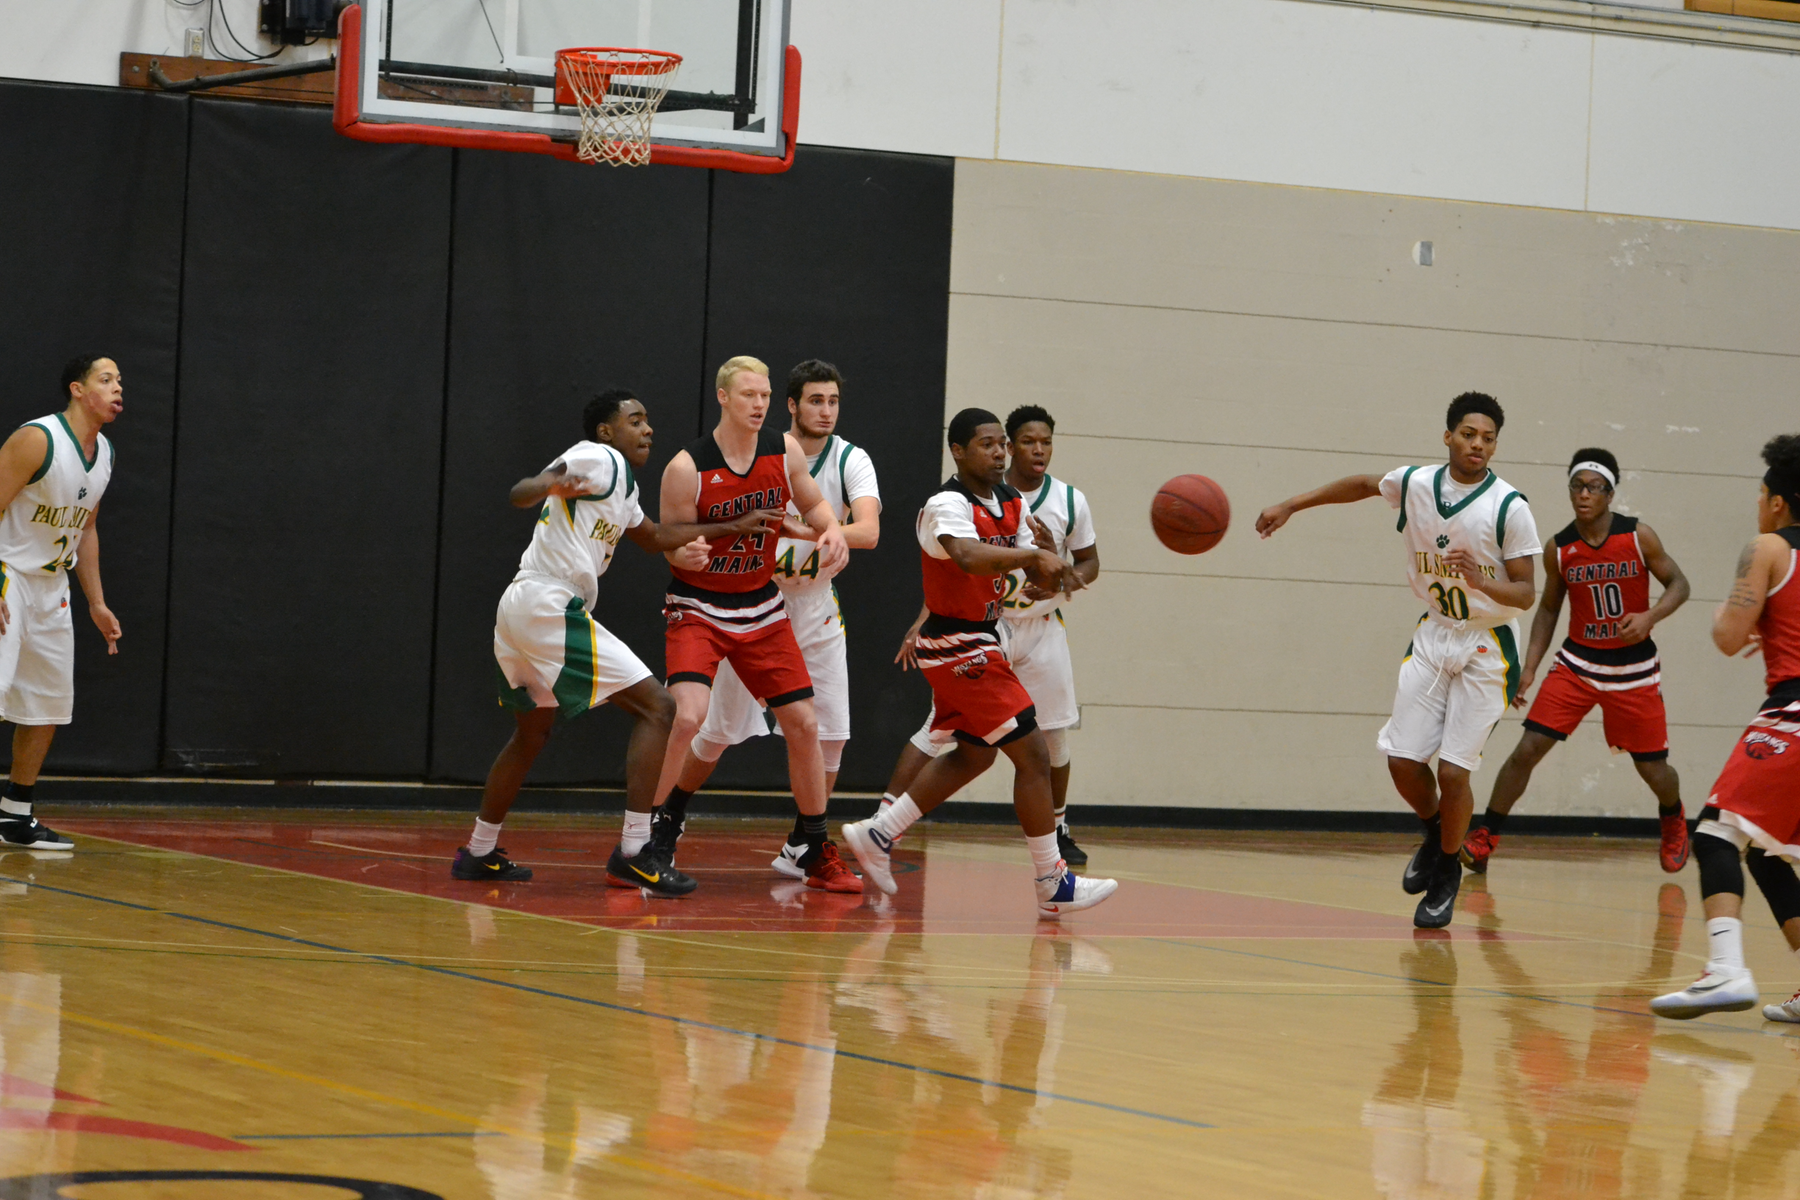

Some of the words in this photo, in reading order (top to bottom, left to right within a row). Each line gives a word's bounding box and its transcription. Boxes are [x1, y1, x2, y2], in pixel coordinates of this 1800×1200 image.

[774, 544, 821, 581] 44
[1566, 560, 1639, 584] CENTRAL
[1428, 581, 1470, 621] 30
[1587, 582, 1624, 620] 10
